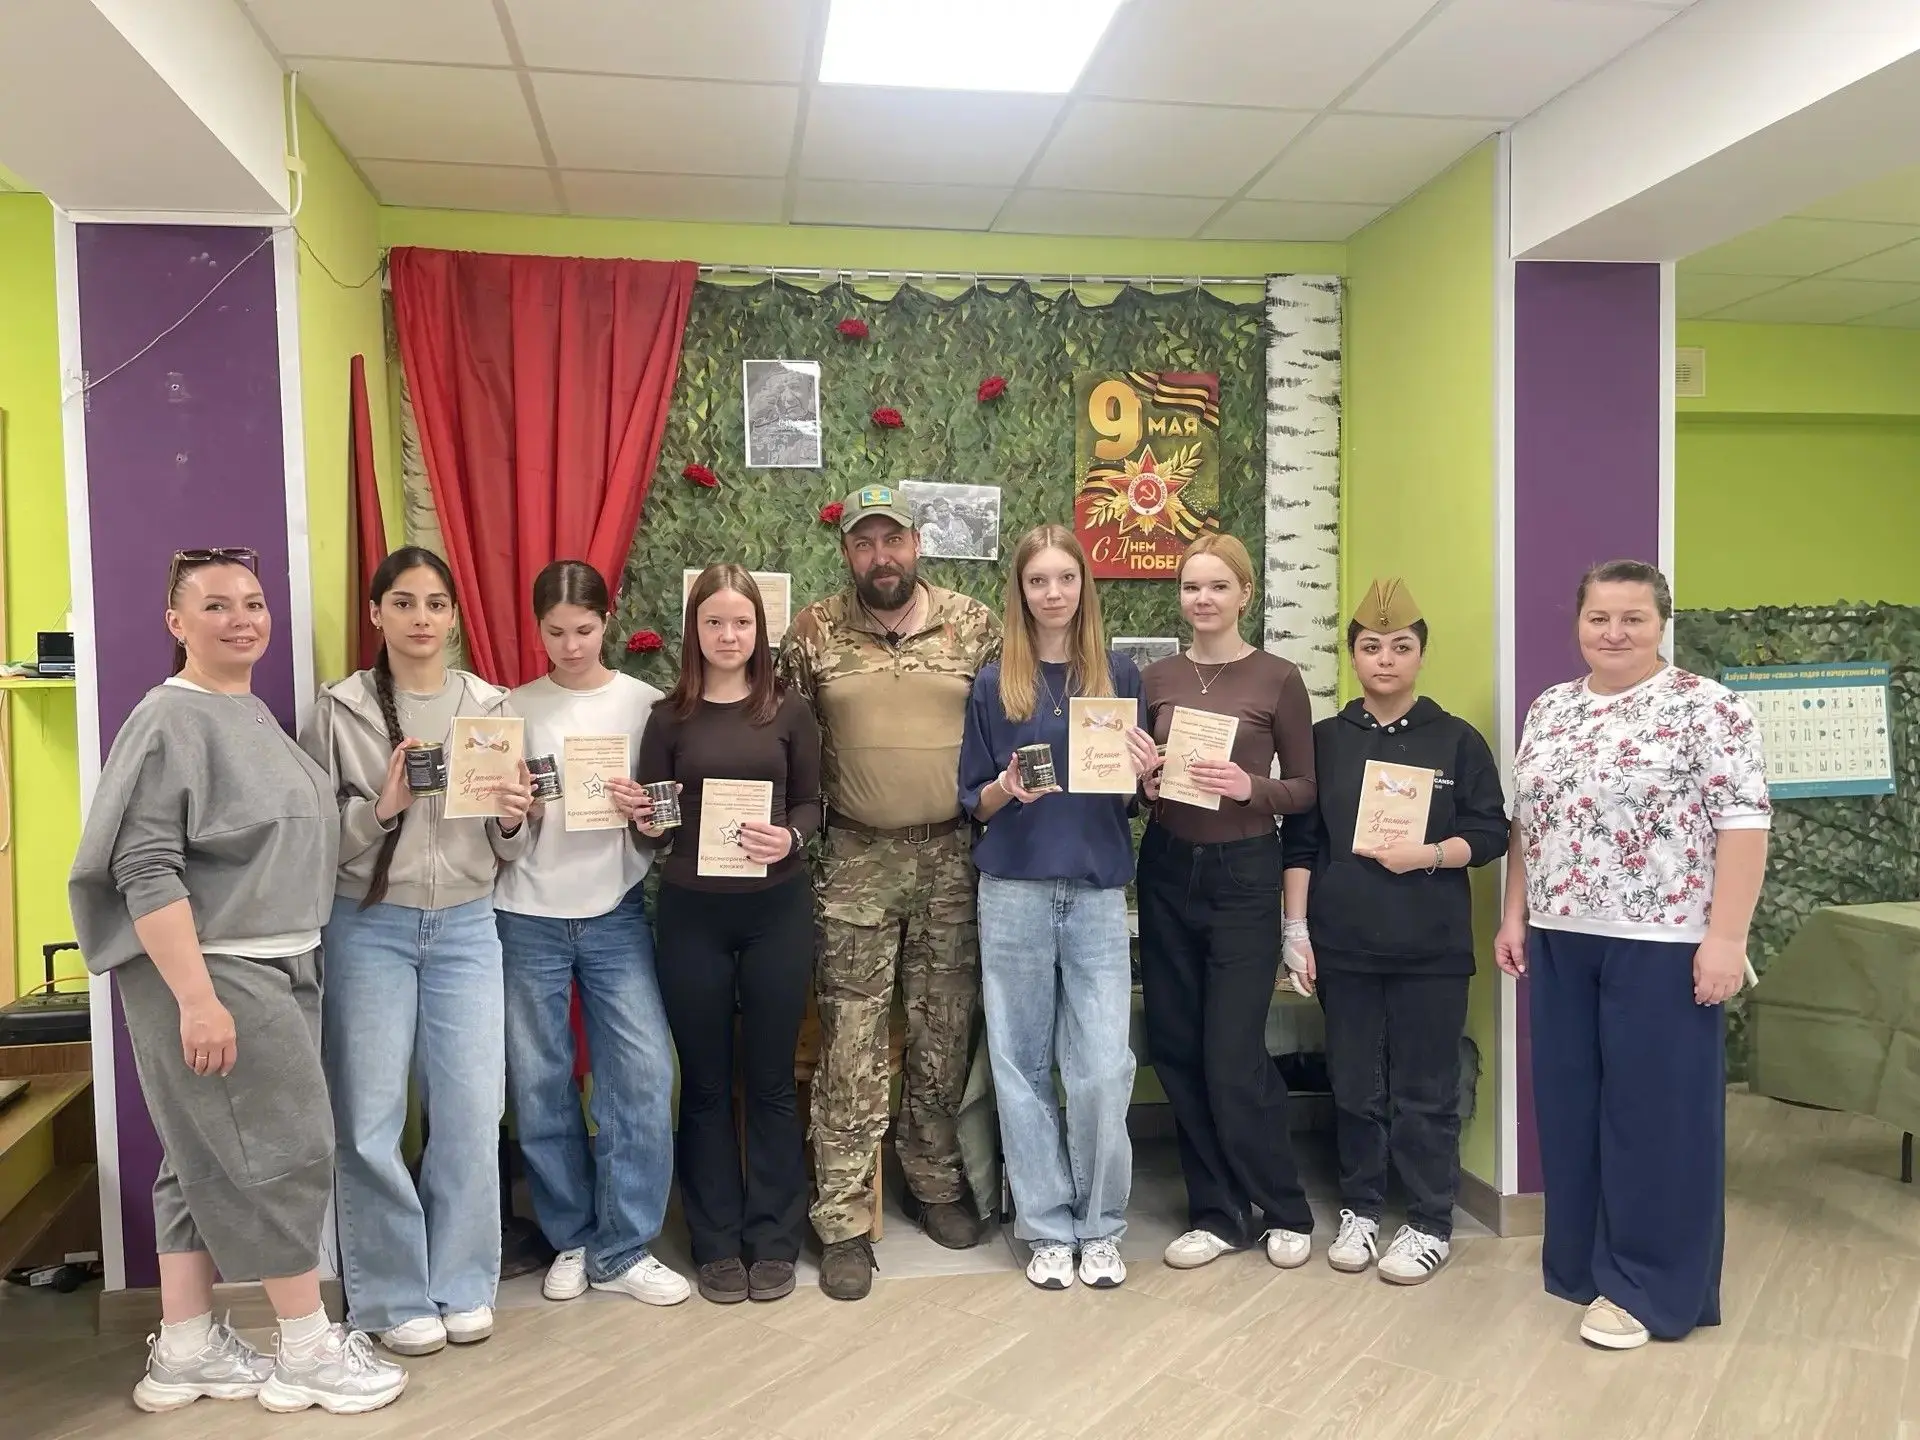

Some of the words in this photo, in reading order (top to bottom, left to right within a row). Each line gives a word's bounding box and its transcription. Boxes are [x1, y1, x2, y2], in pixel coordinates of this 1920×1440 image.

[1089, 380, 1143, 460] 9
[1148, 416, 1199, 437] МАЯ
[1092, 536, 1110, 562] С
[1130, 555, 1182, 570] ПОБЕ
